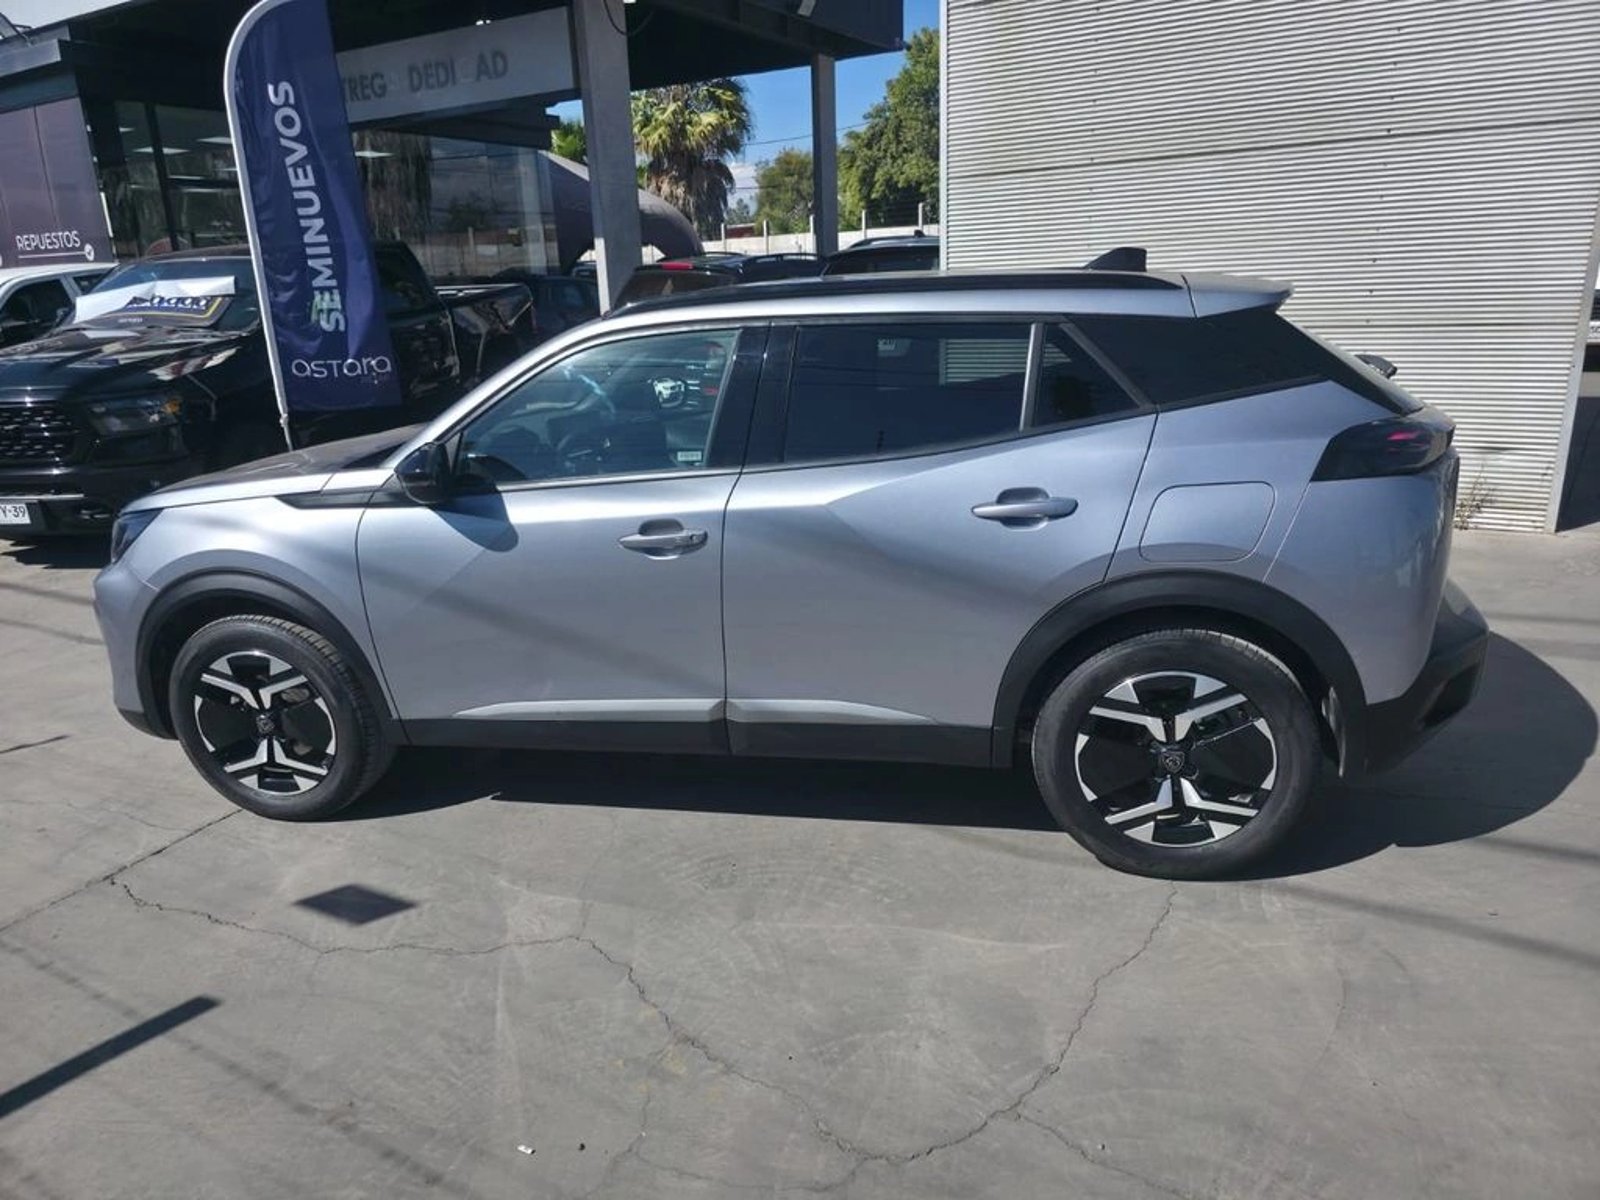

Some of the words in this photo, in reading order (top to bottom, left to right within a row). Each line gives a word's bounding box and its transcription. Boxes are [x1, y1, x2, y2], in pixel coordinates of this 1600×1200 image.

[267, 80, 346, 333] SEMINUEVOS
[15, 230, 81, 251] REPUESTOS
[291, 355, 392, 378] astara
